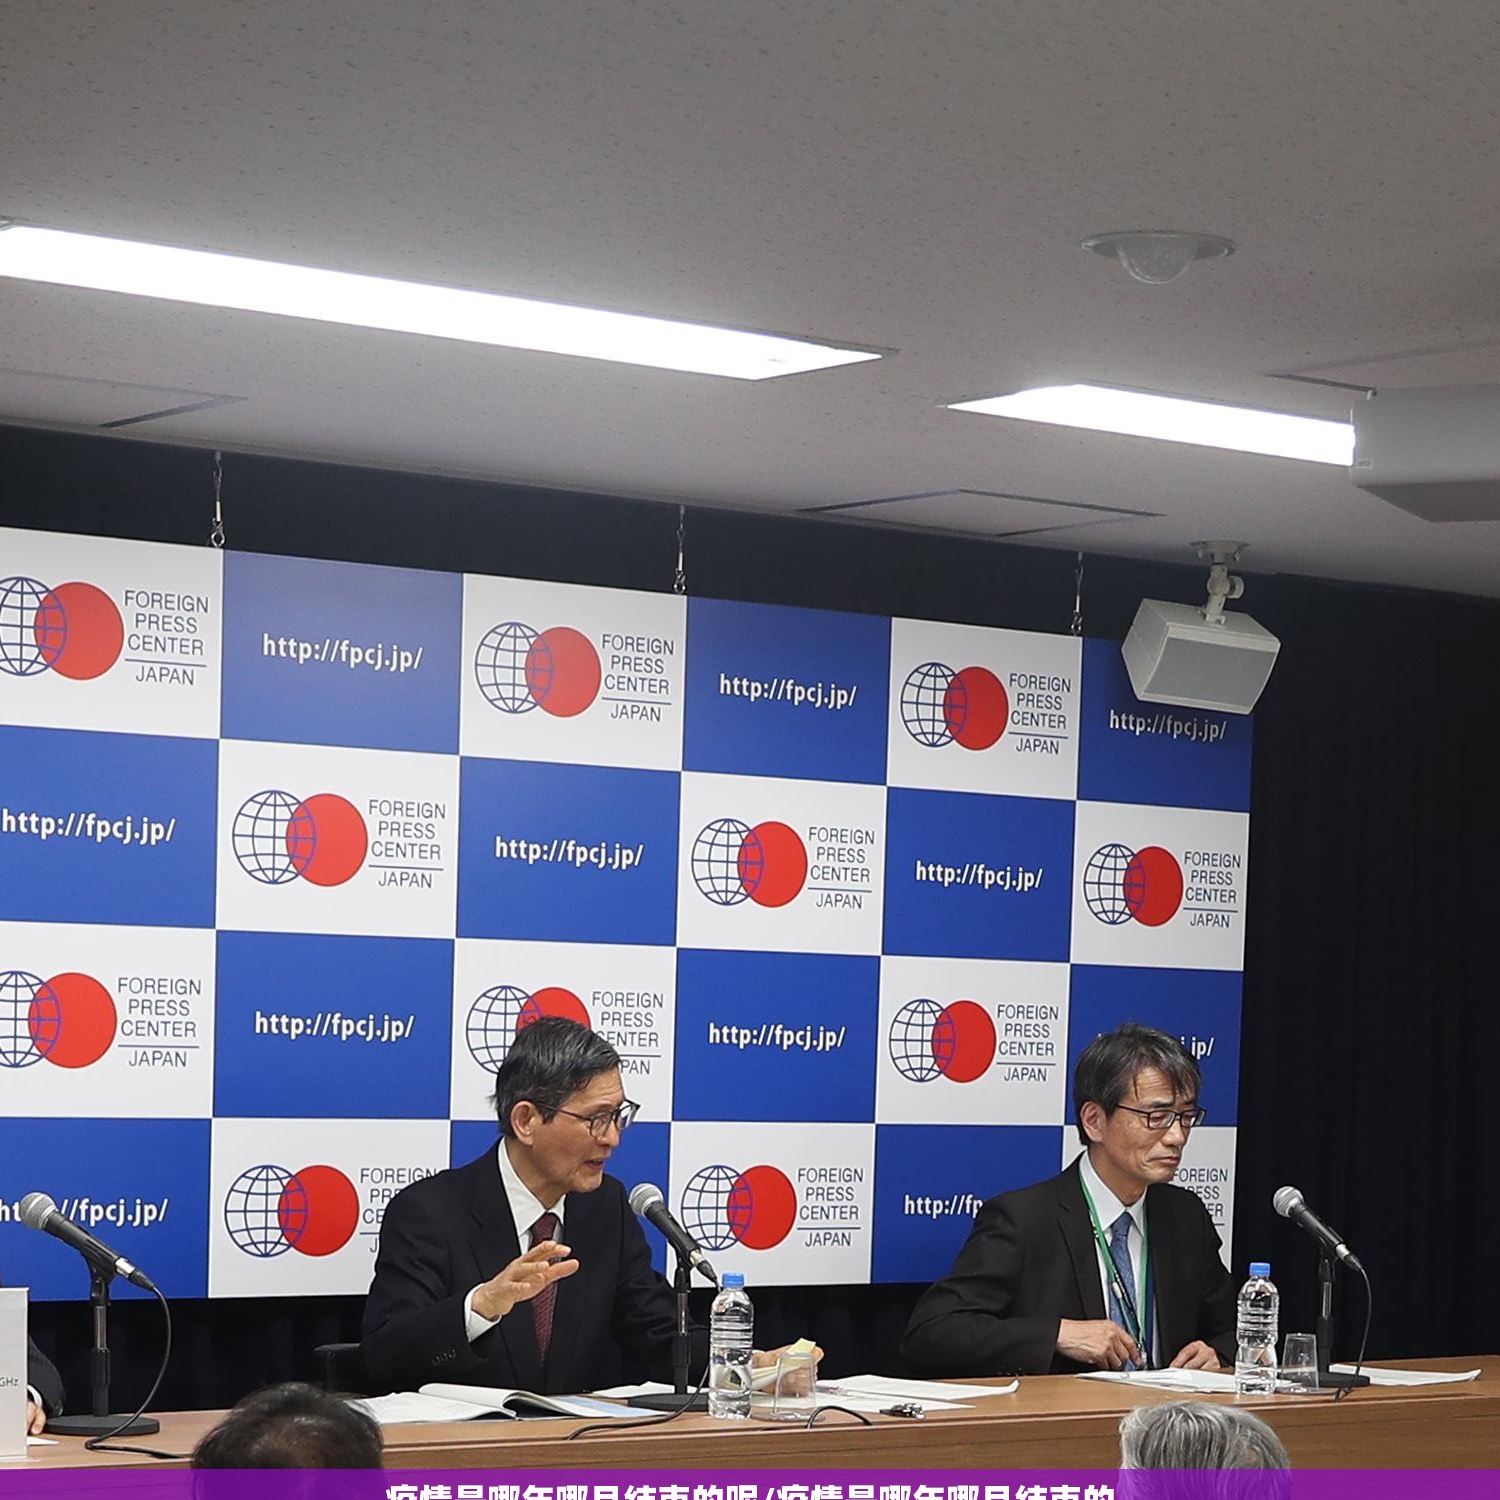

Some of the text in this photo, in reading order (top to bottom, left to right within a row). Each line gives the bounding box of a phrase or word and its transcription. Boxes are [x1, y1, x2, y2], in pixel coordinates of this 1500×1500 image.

[124, 589, 209, 614] FOREIGN
[135, 612, 198, 634] PRESS
[127, 633, 204, 656] CENTER
[263, 633, 423, 673] http://fpcj.jp/
[602, 633, 674, 656] FOREIGN
[610, 654, 664, 675] PRESS
[135, 665, 194, 686] JAPAN
[604, 673, 670, 695] CENTER
[1009, 672, 1072, 693] FOREIGN
[720, 673, 857, 710] http://fpcj.jp/
[1016, 692, 1063, 711] PRESS
[610, 703, 661, 723] JAPAN
[1010, 710, 1067, 730] CENTER
[1109, 709, 1227, 742] http://fpcj.jp/
[1015, 737, 1060, 755] JAPAN
[368, 799, 446, 820] FOREIGN
[2, 808, 176, 846] http://fpcj.jp/
[378, 820, 436, 840] PRESS
[808, 826, 875, 845] FOREIGN
[371, 840, 441, 860] CENTER
[495, 835, 644, 870] http://fpcj.jp/
[816, 846, 866, 864] PRESS
[1184, 850, 1242, 869] FOREIGN
[378, 871, 432, 889] JAPAN
[810, 864, 870, 883] CENTER
[916, 860, 1043, 892] http://fpcj.jp/
[1190, 869, 1233, 886] PRESS
[815, 893, 862, 910] JAPAN
[1185, 886, 1237, 904] CENTER
[1189, 913, 1230, 929] JAPAN
[117, 976, 201, 996] FOREIGN
[128, 998, 190, 1017] PRESS
[592, 991, 664, 1009] FOREIGN
[600, 1011, 654, 1028] PRESS
[997, 1004, 1059, 1021] FOREIGN
[120, 1019, 197, 1038] CENTER
[255, 1010, 414, 1042] http://fpcj.jp/
[1004, 1022, 1050, 1039] PRESS
[709, 1022, 846, 1052] http://fpcj.jp/
[998, 1040, 1055, 1057] CENTER
[128, 1050, 187, 1068] JAPAN
[621, 1060, 650, 1074] PAN
[1003, 1066, 1047, 1082] JAPAN
[797, 1167, 864, 1184] FOREIGN
[805, 1186, 855, 1202] PRESS
[799, 1205, 859, 1221] CENTER
[804, 1231, 852, 1248] JAPAN
